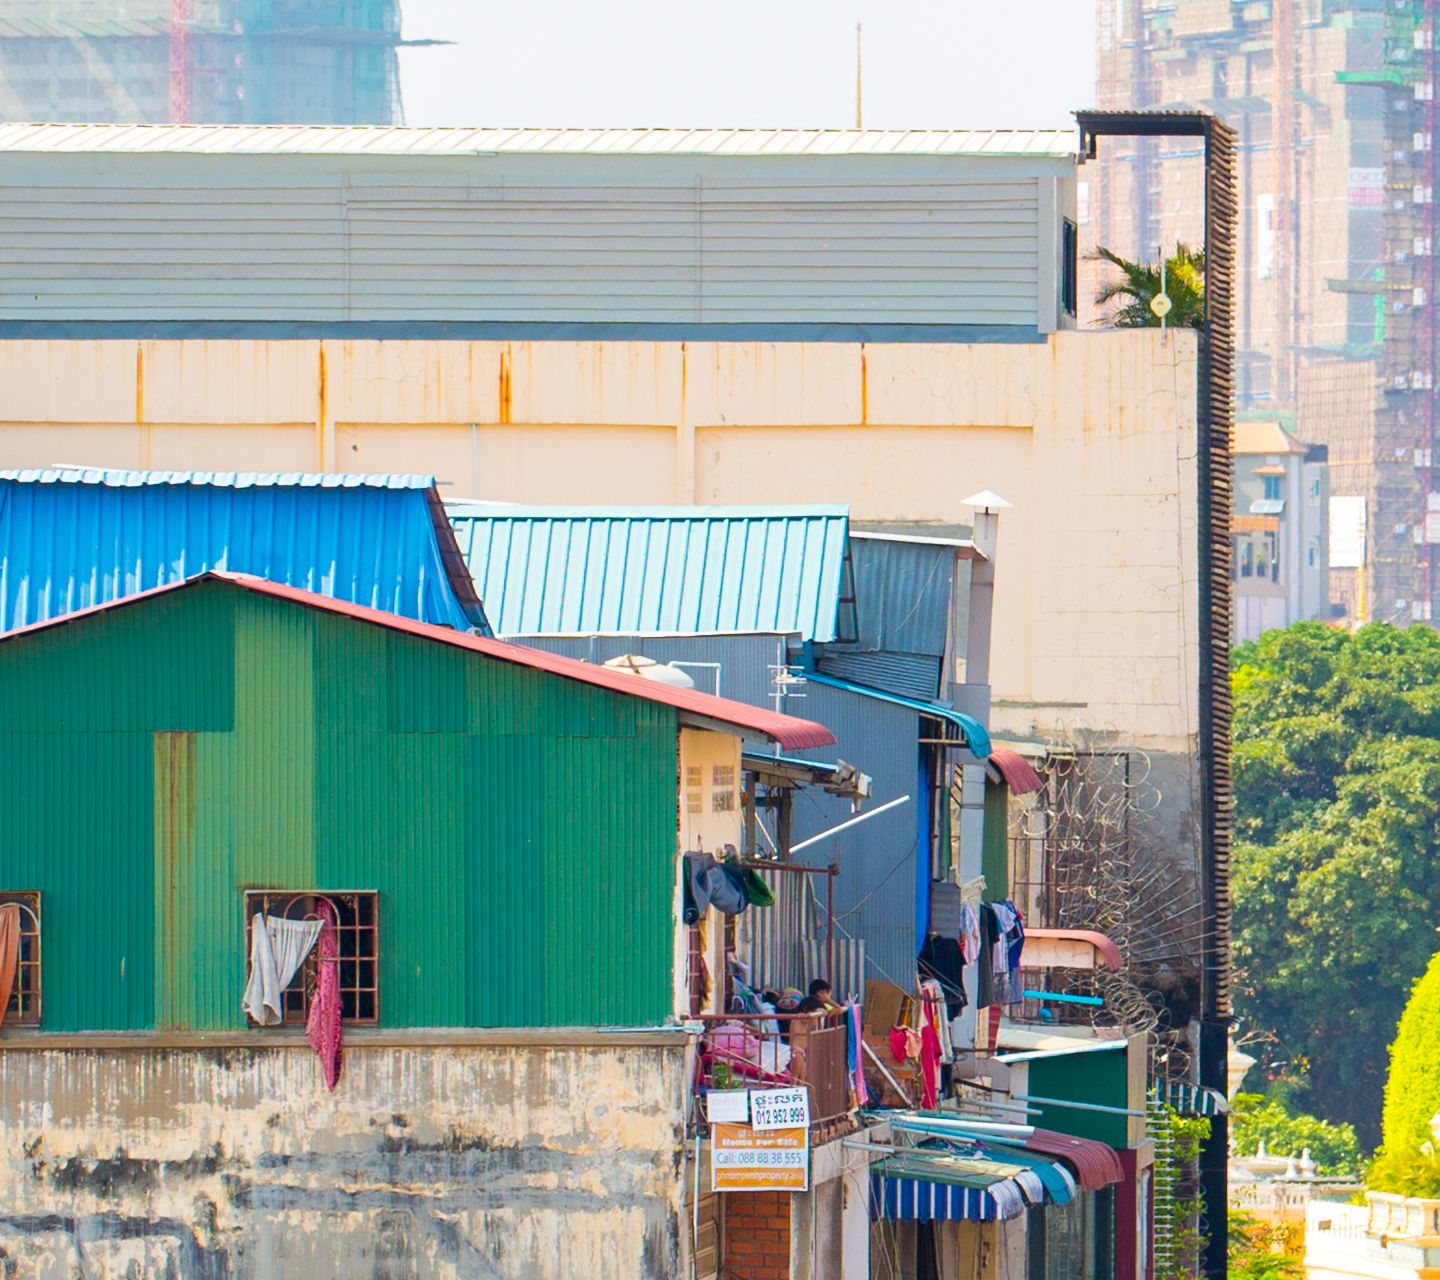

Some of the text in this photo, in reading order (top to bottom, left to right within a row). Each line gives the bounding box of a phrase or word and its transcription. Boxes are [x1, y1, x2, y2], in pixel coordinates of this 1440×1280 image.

[757, 1107, 805, 1125] 012 952 999
[739, 1152, 755, 1164] 088
[771, 1152, 783, 1164] 38
[784, 1152, 802, 1164] 555
